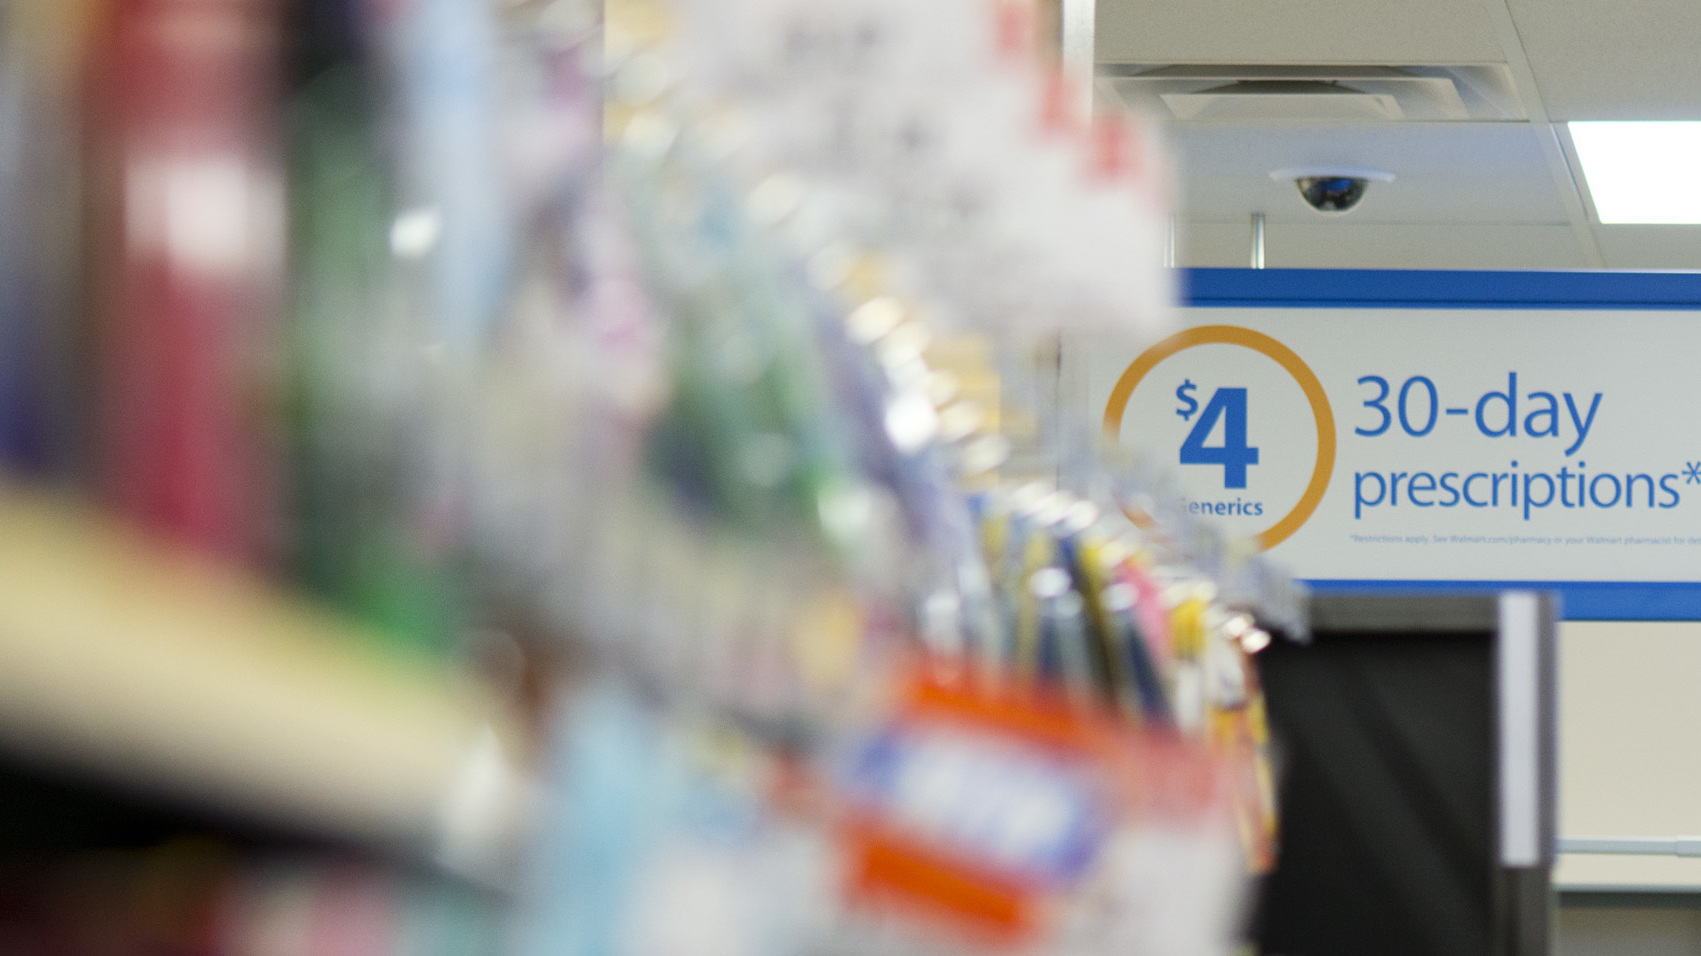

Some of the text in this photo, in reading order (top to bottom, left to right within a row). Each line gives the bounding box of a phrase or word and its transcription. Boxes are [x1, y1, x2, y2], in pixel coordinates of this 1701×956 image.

[1175, 378, 1259, 489] $4
[1354, 373, 1602, 456] 30-day
[1181, 498, 1263, 516] enerics
